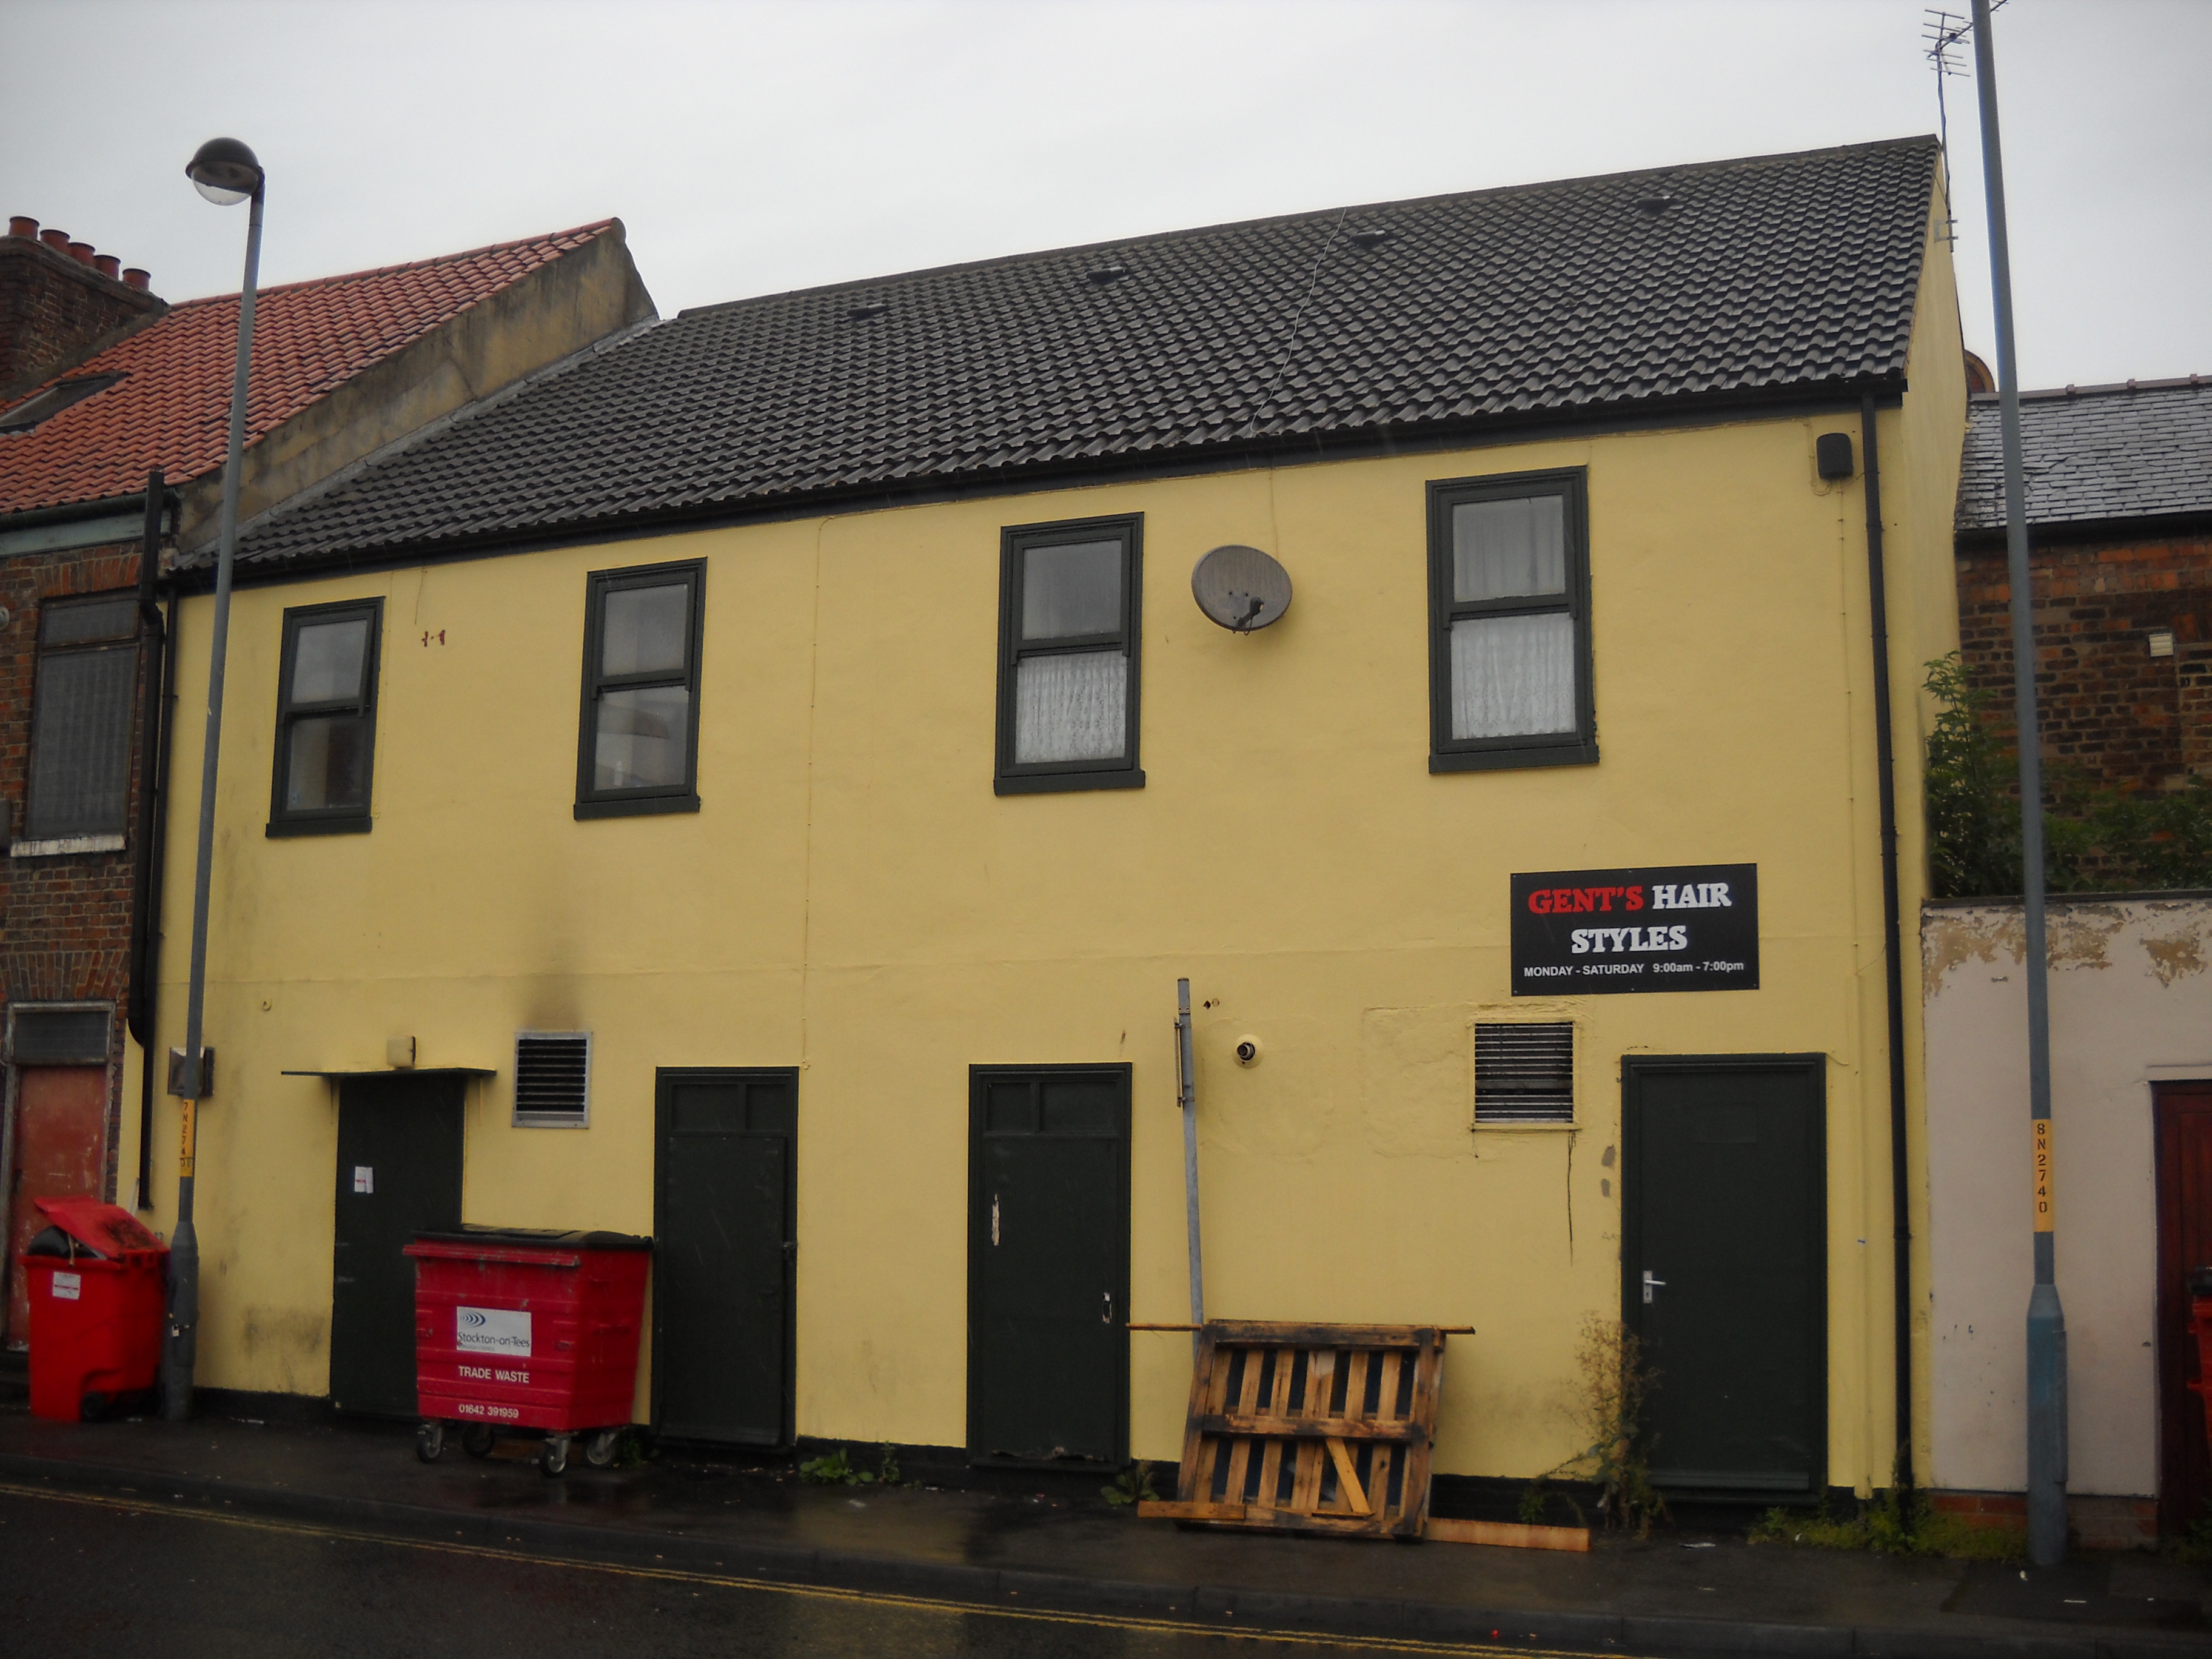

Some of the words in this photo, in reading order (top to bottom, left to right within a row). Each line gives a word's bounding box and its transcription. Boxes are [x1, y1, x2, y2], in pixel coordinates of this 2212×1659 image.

[1527, 885, 1644, 914] GENT'S
[1652, 882, 1732, 910] HAIR
[1571, 925, 1688, 954] STYLES
[1524, 966, 1574, 977] MONDAY
[1582, 964, 1644, 975] SATURDAY
[1652, 962, 1694, 973] 9:00am
[1703, 960, 1744, 973] 7:00pm
[458, 1332, 530, 1347] Stockton-on-Tees
[458, 1366, 492, 1379] TRADE
[495, 1369, 529, 1384] WASTE
[458, 1404, 484, 1415] 01642
[488, 1406, 519, 1418] 391959
